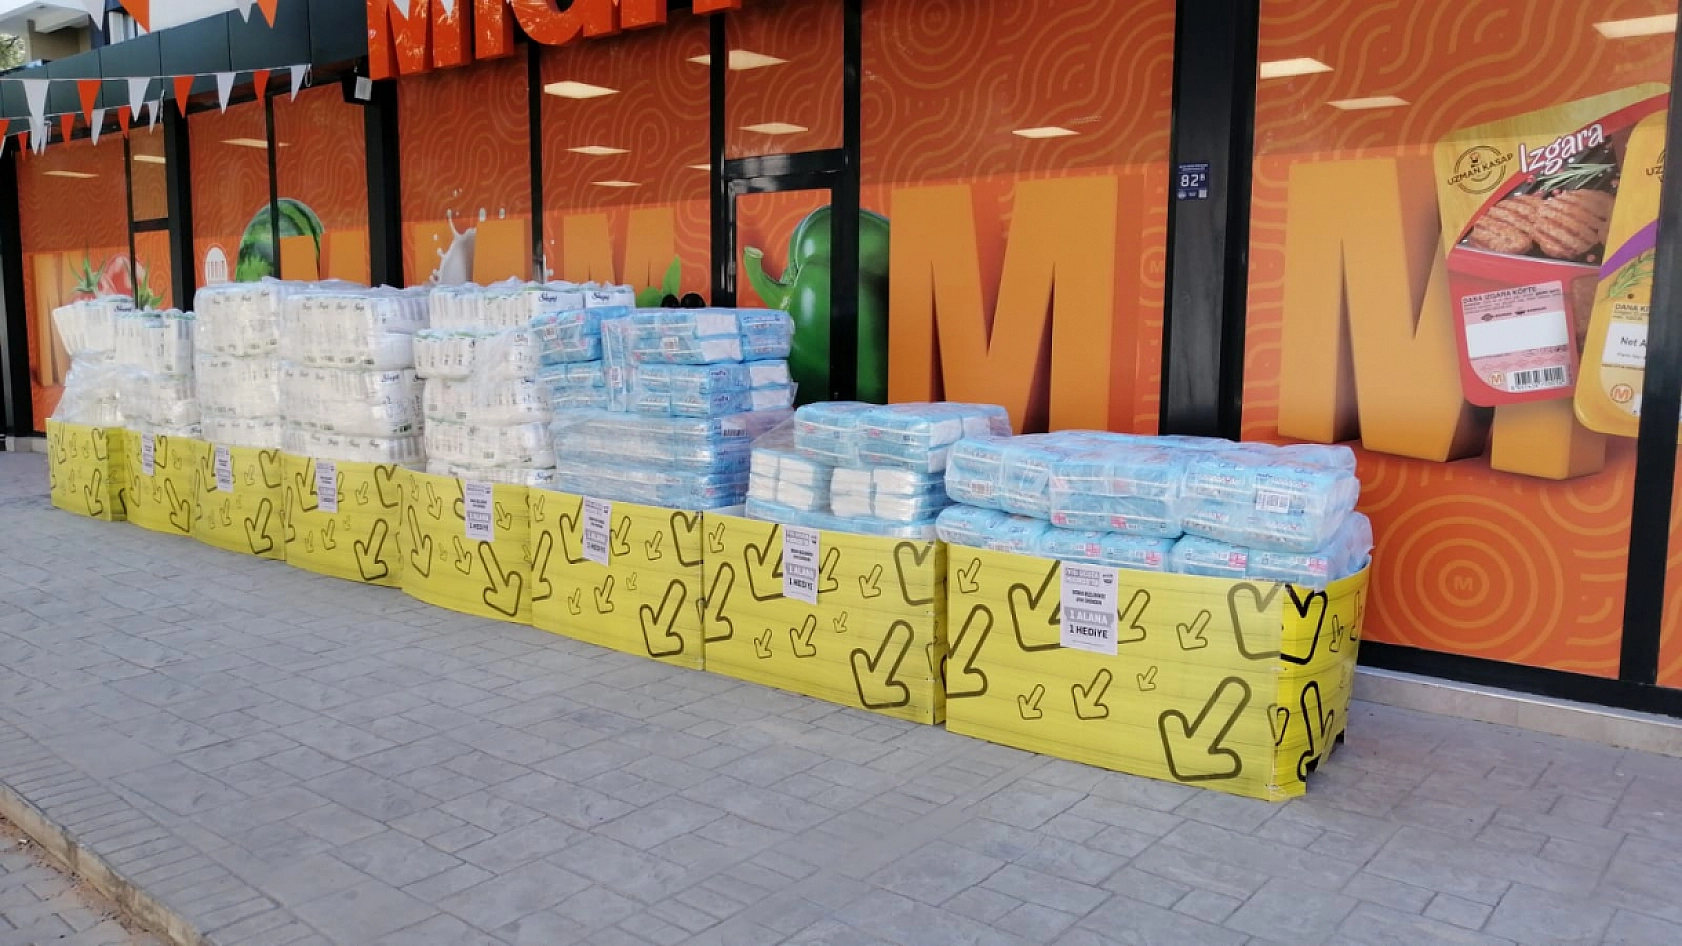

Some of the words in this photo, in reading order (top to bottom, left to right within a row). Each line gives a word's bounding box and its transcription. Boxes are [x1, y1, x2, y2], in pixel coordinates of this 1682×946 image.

[1519, 123, 1604, 175] Izgara
[1447, 165, 1481, 185] UZMAN
[1482, 152, 1514, 171] KASAP
[1069, 624, 1075, 634] 1
